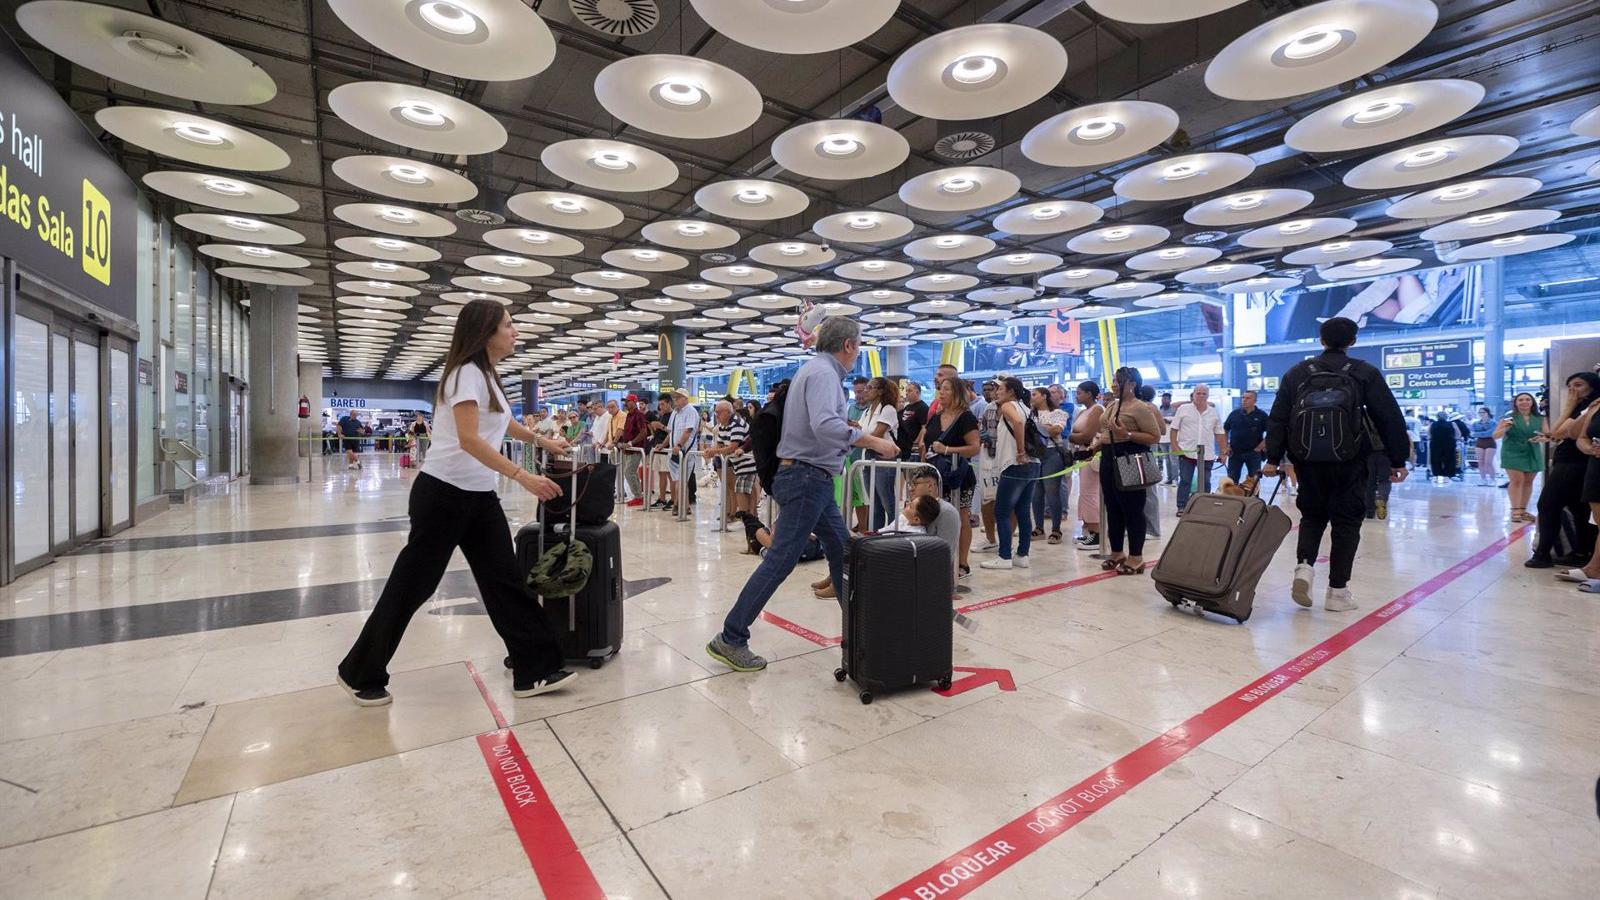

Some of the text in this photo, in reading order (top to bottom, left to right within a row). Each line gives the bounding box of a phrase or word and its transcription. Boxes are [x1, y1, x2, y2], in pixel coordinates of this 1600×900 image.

[12, 113, 42, 177] hall
[38, 195, 73, 258] Sala
[86, 200, 108, 267] 10
[330, 398, 366, 408] BARETO
[1439, 378, 1471, 386] Ciudad
[492, 744, 538, 808] DO NOT BLOCK
[914, 775, 1124, 900] BLOQUEAR DO NOT BLOCK
